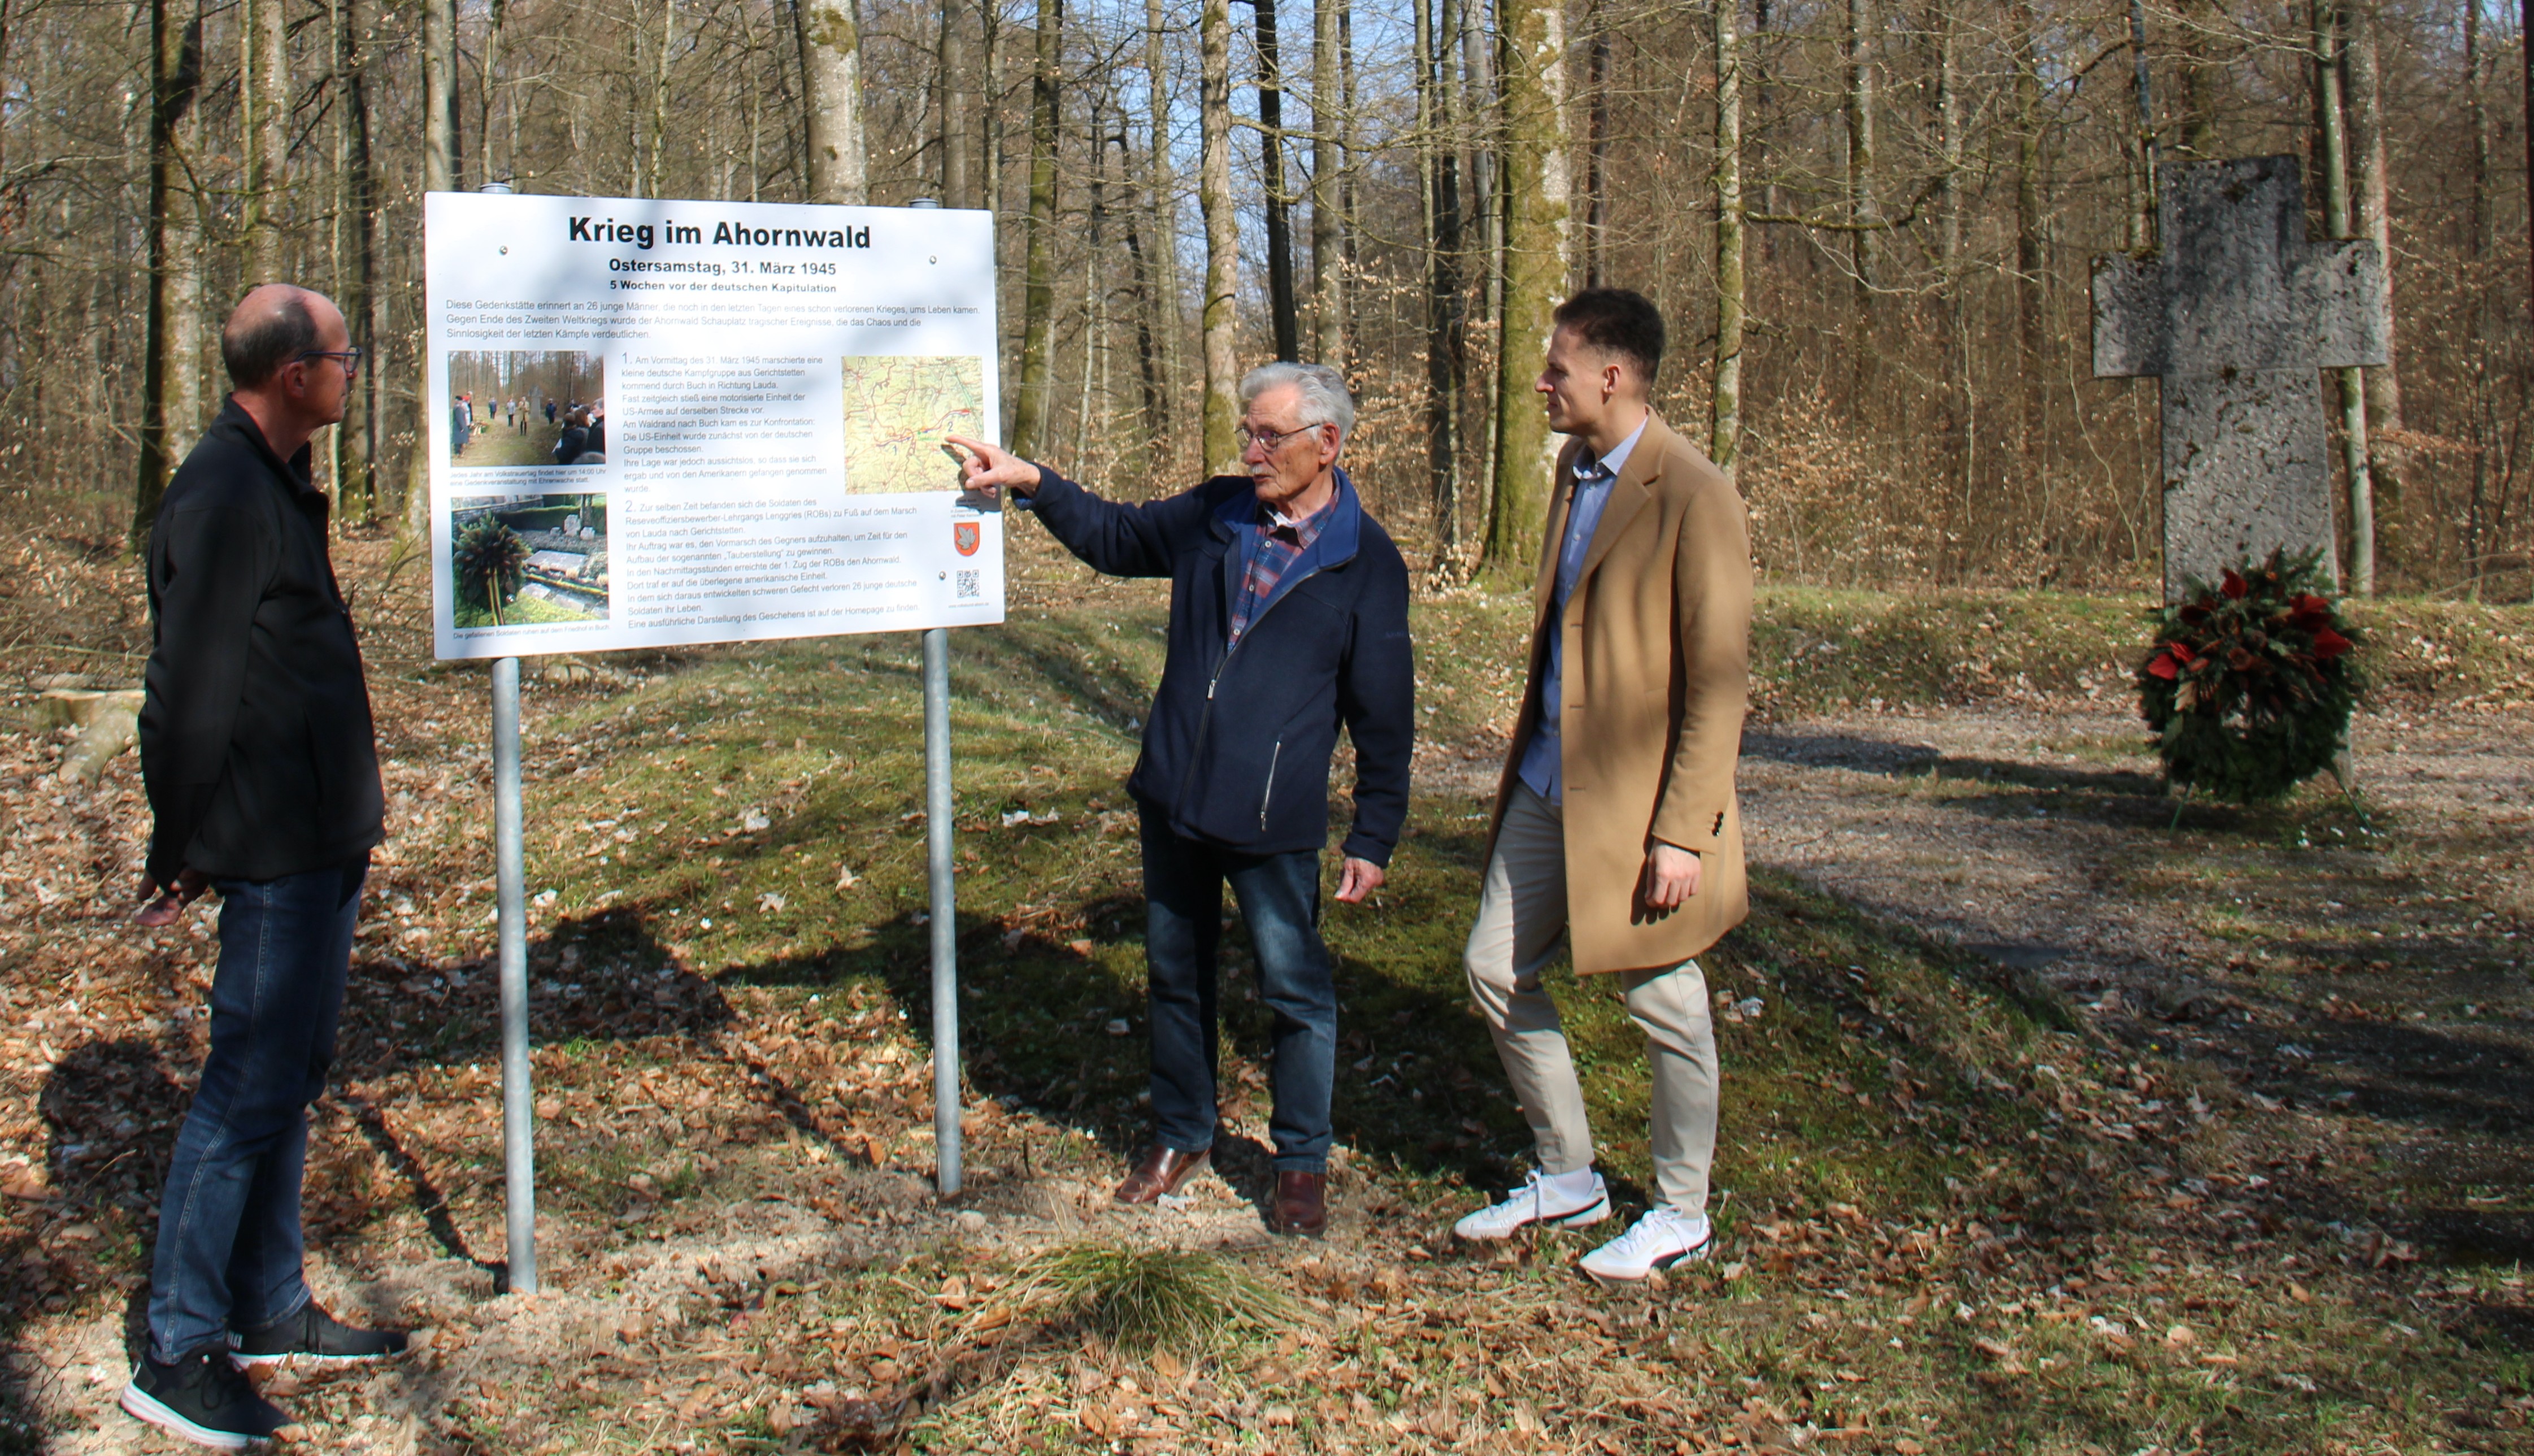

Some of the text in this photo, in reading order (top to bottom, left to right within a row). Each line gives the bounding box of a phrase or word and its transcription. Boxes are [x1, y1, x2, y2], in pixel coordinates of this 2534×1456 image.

[569, 217, 870, 249] Krieg im Ahornwald
[608, 258, 836, 275] Ostersamstag, 31. März 1945
[609, 280, 617, 290] 5
[619, 280, 665, 290] Wochen
[689, 281, 707, 290] der
[711, 282, 768, 292] deutschen
[771, 283, 836, 293] Kapitulation
[445, 299, 472, 309] Diese
[474, 299, 535, 310] Gedenkstätte
[537, 301, 571, 310] erinnert
[586, 301, 598, 310] 26
[599, 302, 624, 313] junge
[626, 302, 660, 311] Männer,
[678, 303, 698, 311] noch
[701, 303, 708, 311] in
[710, 303, 726, 311] den
[757, 303, 781, 314] Tagen
[876, 305, 908, 315] Krieges,
[927, 305, 951, 314] Leben
[953, 305, 980, 314] kamen.
[446, 314, 921, 328] Gegen Ende des Zweiten Weltkriegs wurde der Ahornwald Schauplatz tragischer Ereignisse, die das Chaos und die
[446, 328, 651, 340] Sinnlosigkeit der letzten Kämpfe verdeutlichen.
[621, 351, 632, 364] 1.
[634, 355, 649, 364] Am
[650, 356, 688, 366] Vormittag
[720, 355, 739, 364] März
[741, 355, 760, 364] 1945
[621, 380, 779, 390] kommend durch Buch in Richtung Lauda.
[621, 394, 640, 403] Fast
[641, 394, 678, 404] zeitgleich
[680, 393, 699, 402] stieß
[719, 393, 764, 402] motorisierte
[766, 393, 792, 401] Einheit
[792, 392, 806, 401] der
[622, 407, 664, 415] US-Armee
[665, 406, 679, 415] auf
[679, 406, 718, 415] derselben
[719, 406, 749, 414] Strecke
[622, 420, 636, 428] Am
[637, 419, 676, 428] Waldrand
[677, 419, 697, 428] nach
[698, 419, 719, 427] Buch
[763, 417, 815, 426] Konfrontation:
[947, 421, 953, 432] 2
[893, 445, 897, 456] 1
[624, 499, 636, 512] 2.
[765, 511, 802, 521] Lenggries
[803, 509, 832, 519] (ROBs)
[844, 508, 859, 517] Fuß
[860, 507, 872, 516] auf
[873, 507, 889, 516] dem
[890, 506, 917, 515] Marsch
[625, 542, 637, 551] Ihr
[637, 542, 667, 551] Auftrag
[698, 540, 714, 548] den
[715, 538, 757, 547] Vormarsch
[758, 537, 772, 545] des
[773, 536, 806, 546] Gegners
[807, 534, 852, 543] aufzuhalten,
[867, 531, 881, 541] Zeit
[882, 531, 893, 540] für
[893, 531, 908, 539] den
[625, 555, 654, 564] Aufbau
[656, 554, 670, 563] der
[671, 553, 721, 563] sogenannten
[796, 547, 834, 558] gewinnen.
[627, 568, 634, 577] In
[653, 565, 732, 575] Nachmittagsstunden
[734, 563, 767, 571] erreichte
[768, 562, 782, 570] der
[784, 560, 790, 569] 1.
[792, 560, 807, 570] Zug
[809, 559, 821, 568] der
[823, 558, 845, 567] ROBs
[846, 557, 860, 566] den
[861, 555, 901, 564] Ahornwald.
[627, 581, 644, 590] Dort
[646, 580, 659, 589] traf
[671, 578, 684, 588] auf
[685, 578, 698, 587] die
[699, 577, 742, 586] überlegene
[744, 573, 798, 584] amerikanische
[800, 571, 827, 581] Einheit.
